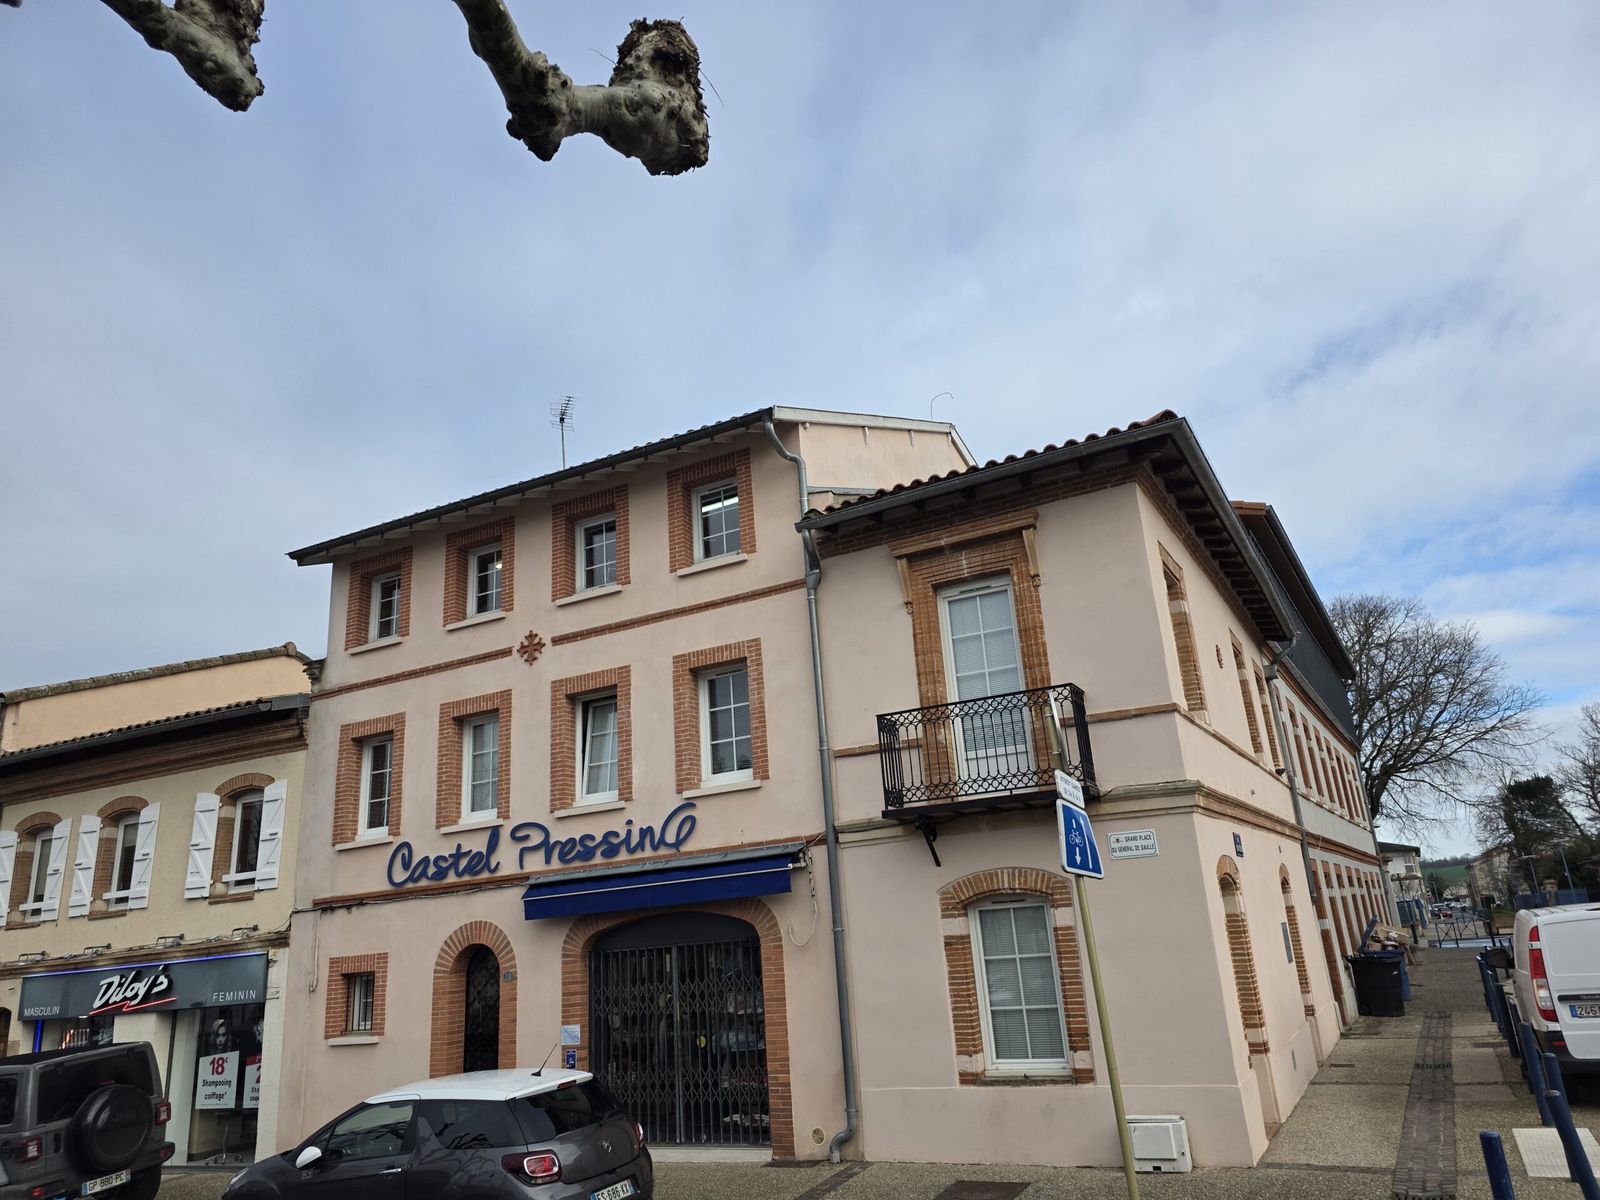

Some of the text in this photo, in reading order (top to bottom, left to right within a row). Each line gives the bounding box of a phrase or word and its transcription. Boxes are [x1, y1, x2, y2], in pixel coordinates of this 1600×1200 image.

[386, 826, 501, 888] Castel
[93, 965, 169, 1008] Diloy's
[212, 989, 257, 1002] FEMININ
[23, 1006, 60, 1017] MASCULIN
[1577, 1005, 1600, 1016] 246
[202, 1079, 232, 1088] Shampooing
